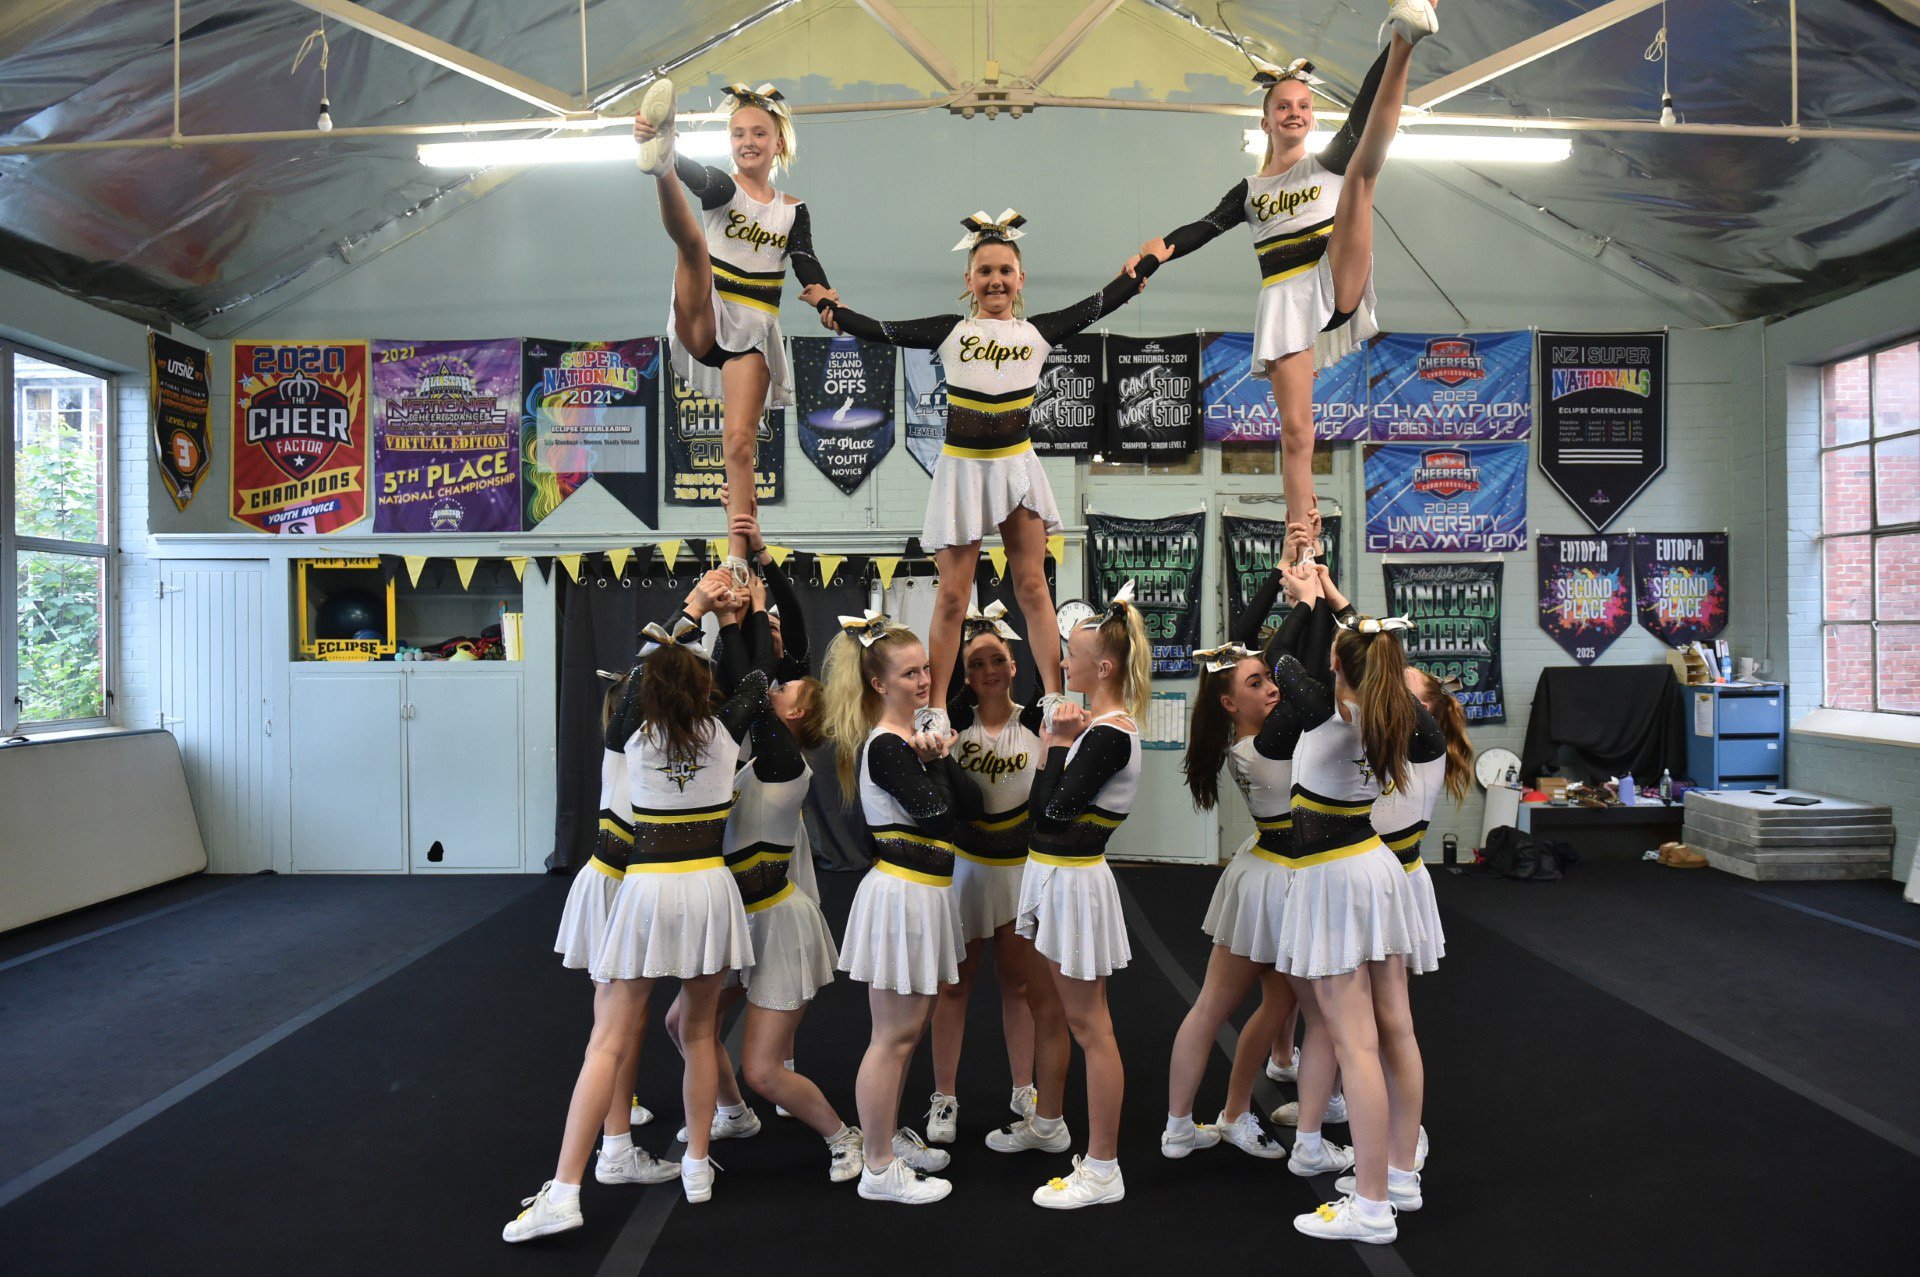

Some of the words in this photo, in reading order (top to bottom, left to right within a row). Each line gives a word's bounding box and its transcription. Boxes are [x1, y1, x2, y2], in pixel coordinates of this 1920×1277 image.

[1252, 186, 1322, 222] Eclipse
[725, 210, 788, 252] Eclipse
[253, 347, 346, 374] 2020
[381, 346, 416, 364] 2021
[561, 351, 622, 369] SUPER
[830, 352, 858, 360] SOUTH
[960, 336, 1032, 370] Eclipse
[1074, 354, 1090, 364] 2021
[1118, 355, 1132, 364] CNZ
[1133, 354, 1170, 364] NATIONALS
[1171, 354, 1188, 362] 2021
[1552, 346, 1578, 364] NZ
[1588, 346, 1650, 364] SUPER
[168, 359, 194, 380] UTSNZ
[828, 360, 862, 368] ISLAND
[1418, 357, 1482, 370] CHEERFEST
[826, 368, 864, 378] SHOW
[544, 368, 638, 396] NATIONALS
[824, 380, 866, 394] OFFS
[1057, 376, 1095, 400] STOP
[1119, 364, 1164, 398] CAN'T
[1154, 376, 1192, 400] STOP
[1552, 368, 1651, 401] NATIONALS
[292, 396, 306, 404] THE
[569, 390, 612, 404] 2021
[1432, 390, 1478, 402] 2023
[386, 397, 507, 418] NATIONAL
[1117, 396, 1164, 428] WON'T
[1374, 403, 1528, 418] CHAMPION
[248, 408, 349, 442] CHEER
[909, 425, 938, 436] LEVEL
[1389, 422, 1428, 435] COED
[1433, 422, 1484, 435] LEVEL
[1490, 421, 1516, 434] 4.2
[276, 440, 324, 454] FACTOR
[386, 436, 448, 450] VIRTUAL
[451, 434, 506, 449] EDITION
[818, 437, 836, 450] 2nd
[837, 437, 874, 450] Place
[1071, 442, 1088, 450] NOVICE
[827, 453, 868, 465] YOUTH
[384, 468, 420, 494] 5TH
[427, 451, 508, 488] PLACE
[675, 472, 724, 486] SENIOR
[832, 468, 862, 476] NOVICE
[1414, 468, 1479, 482] CHEERFEST
[251, 472, 350, 509] CHAMPIONS
[378, 490, 434, 506] NATIONAL
[438, 472, 516, 498] CHAMPIONSHIP
[268, 510, 298, 525] YOUTH
[302, 501, 334, 516] NOVICE
[1424, 503, 1470, 514] 2023
[1388, 514, 1501, 532] UNIVERSITY
[1369, 533, 1525, 549] CHAMPION
[1094, 532, 1199, 570] UNITED
[1557, 578, 1612, 598] SECOND
[1653, 577, 1708, 598] SECOND
[1394, 581, 1496, 618] UNITED
[1659, 598, 1702, 618] PLACE
[1563, 600, 1608, 619] PLACE
[1402, 618, 1490, 656] CHEER
[318, 642, 378, 656] ECLIPSE
[1152, 646, 1184, 658] LEVEL
[1186, 645, 1192, 657] 1
[1576, 647, 1596, 658] 2025
[1159, 660, 1192, 672] TEAM
[1466, 704, 1502, 718] TEAM
[958, 740, 1028, 784] Eclipse
